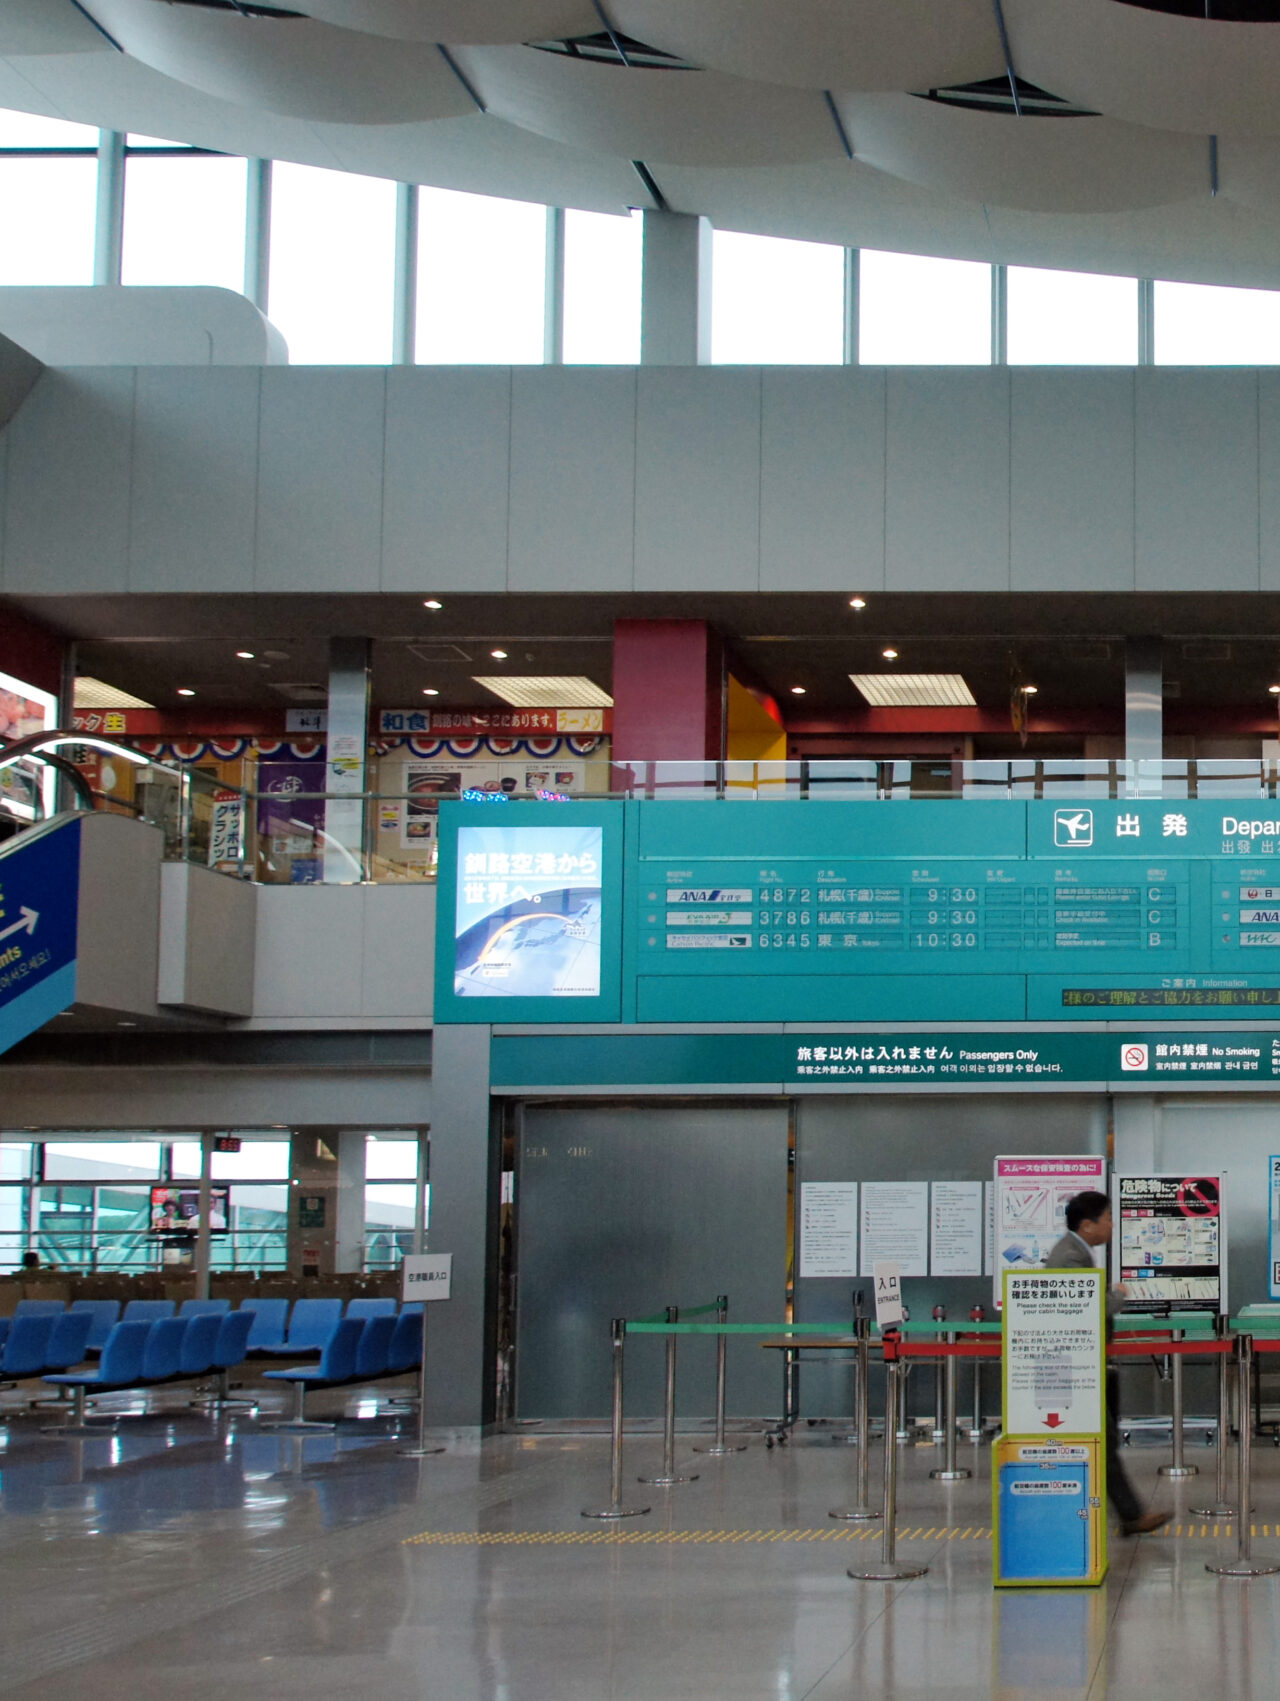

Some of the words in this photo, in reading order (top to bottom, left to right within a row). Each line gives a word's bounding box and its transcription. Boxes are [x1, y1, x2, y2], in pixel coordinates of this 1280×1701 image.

[382, 711, 428, 731] 和食
[557, 711, 603, 731] ラーメン
[226, 803, 240, 858] サッポロ
[1116, 813, 1188, 837] 出発
[464, 852, 598, 874] 釧路空港から
[464, 882, 542, 904] 世界へ。
[678, 892, 707, 901] ANA
[759, 889, 811, 902] 4872
[927, 888, 976, 901] 9:30
[1148, 888, 1161, 900] C
[759, 912, 811, 925] 3786
[927, 910, 976, 923] 9:30
[1148, 910, 1161, 923] C
[1251, 912, 1279, 922] ANA
[759, 934, 811, 947] 6345
[817, 934, 858, 946] 東京
[916, 933, 976, 946] 10:30
[1150, 933, 1161, 946] B
[1162, 979, 1196, 988] ご案内
[1203, 979, 1248, 987] Information
[797, 1047, 953, 1061] 旅客以外は入れません
[959, 1051, 1014, 1062] Passengers
[1016, 1050, 1038, 1061] Only
[1156, 1044, 1208, 1056] 館内禁煙
[1226, 1048, 1260, 1057] Smoking
[941, 1065, 957, 1073] 여객
[960, 1065, 986, 1073] 이외는
[1015, 1065, 1022, 1073] 수
[1025, 1064, 1063, 1073] 없습니다.
[1122, 1180, 1197, 1193] 危険物について
[879, 1277, 896, 1290] 入口
[1012, 1280, 1095, 1288] お手荷物の大きさの
[1012, 1290, 1095, 1299] 確認をお願いします
